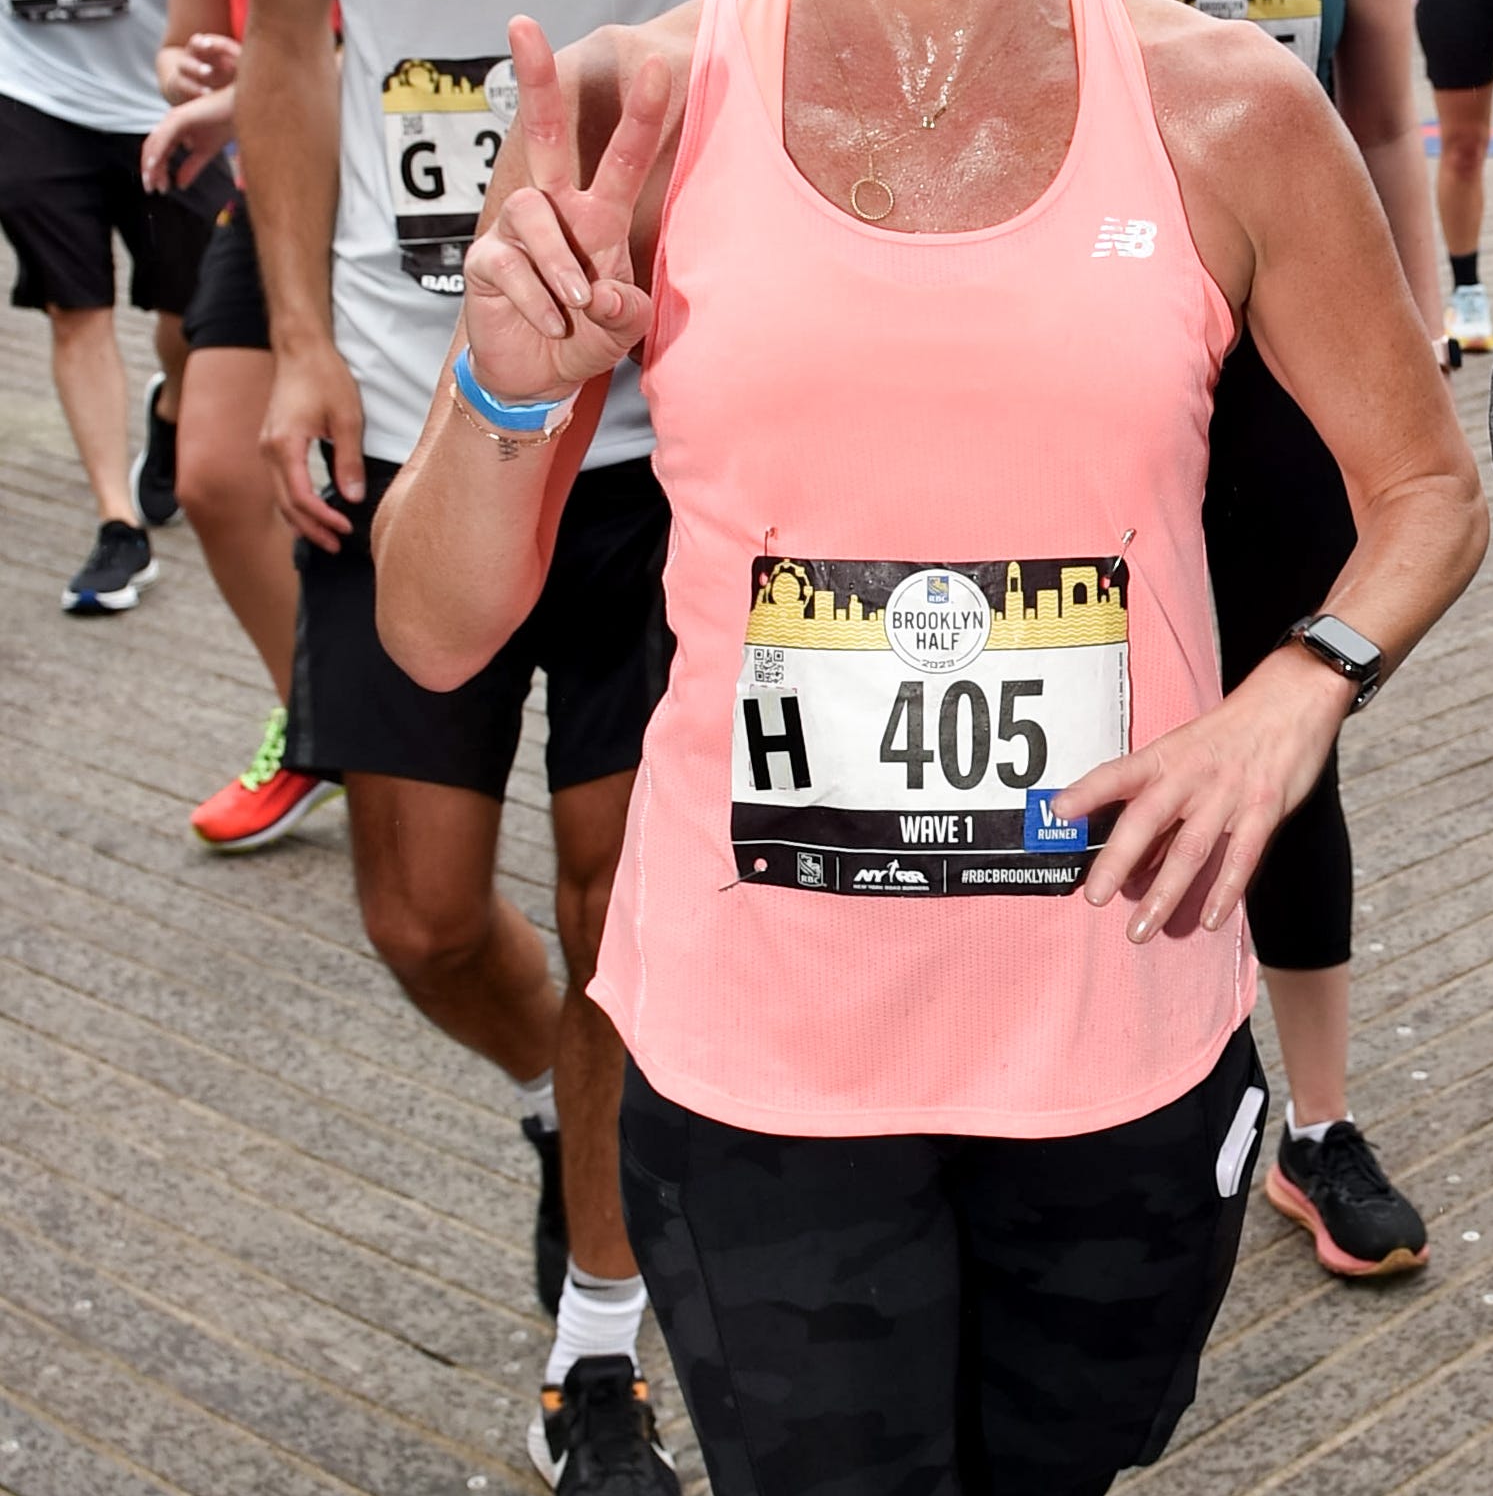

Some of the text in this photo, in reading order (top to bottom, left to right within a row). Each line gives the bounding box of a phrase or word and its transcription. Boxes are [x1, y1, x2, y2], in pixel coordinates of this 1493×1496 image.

[400, 141, 446, 201] G
[892, 611, 984, 630] BROOKLYN
[916, 632, 960, 651] HALF
[921, 659, 955, 669] 2023
[743, 679, 1047, 791] H 405
[900, 815, 973, 844] WAVE 1
[1037, 828, 1078, 840] RUNNER
